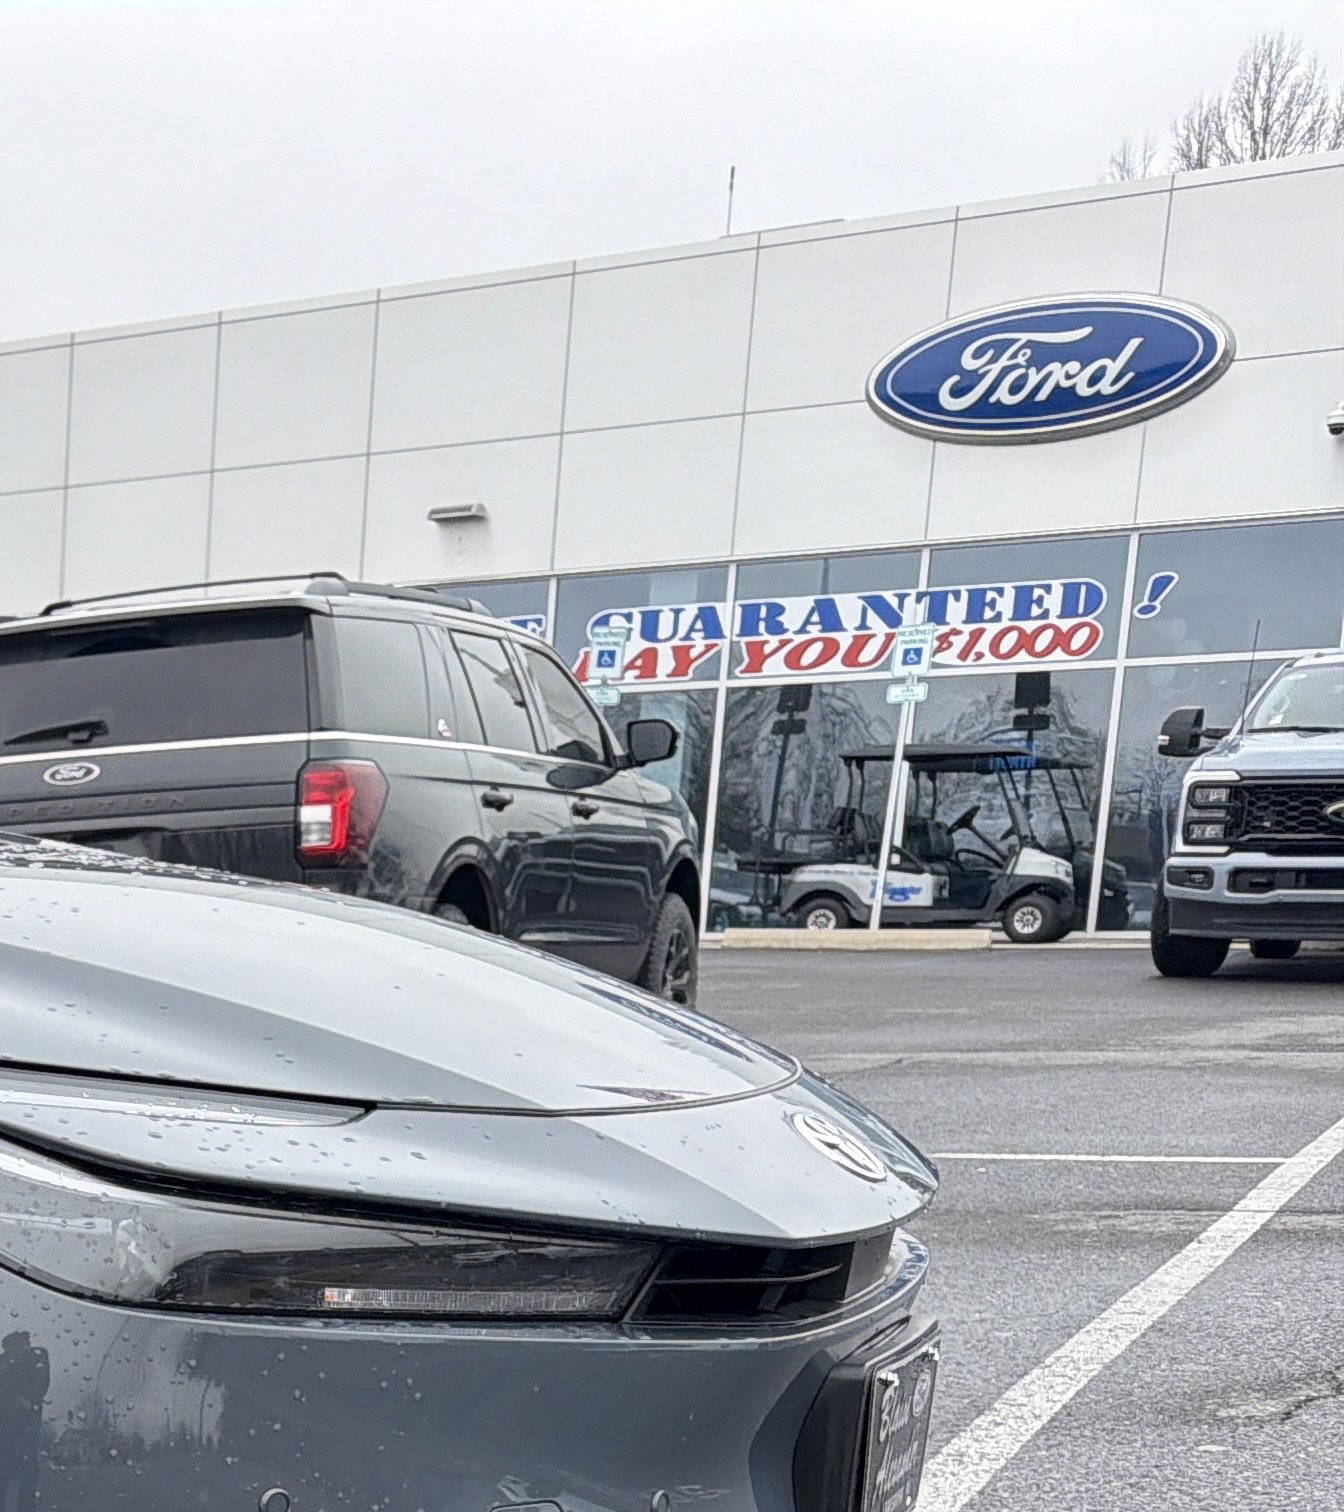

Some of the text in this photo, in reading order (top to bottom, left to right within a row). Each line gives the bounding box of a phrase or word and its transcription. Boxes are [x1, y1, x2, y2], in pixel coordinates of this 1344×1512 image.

[938, 326, 1144, 412] Ford
[739, 632, 897, 674] YOU
[932, 621, 1101, 662] $1,000
